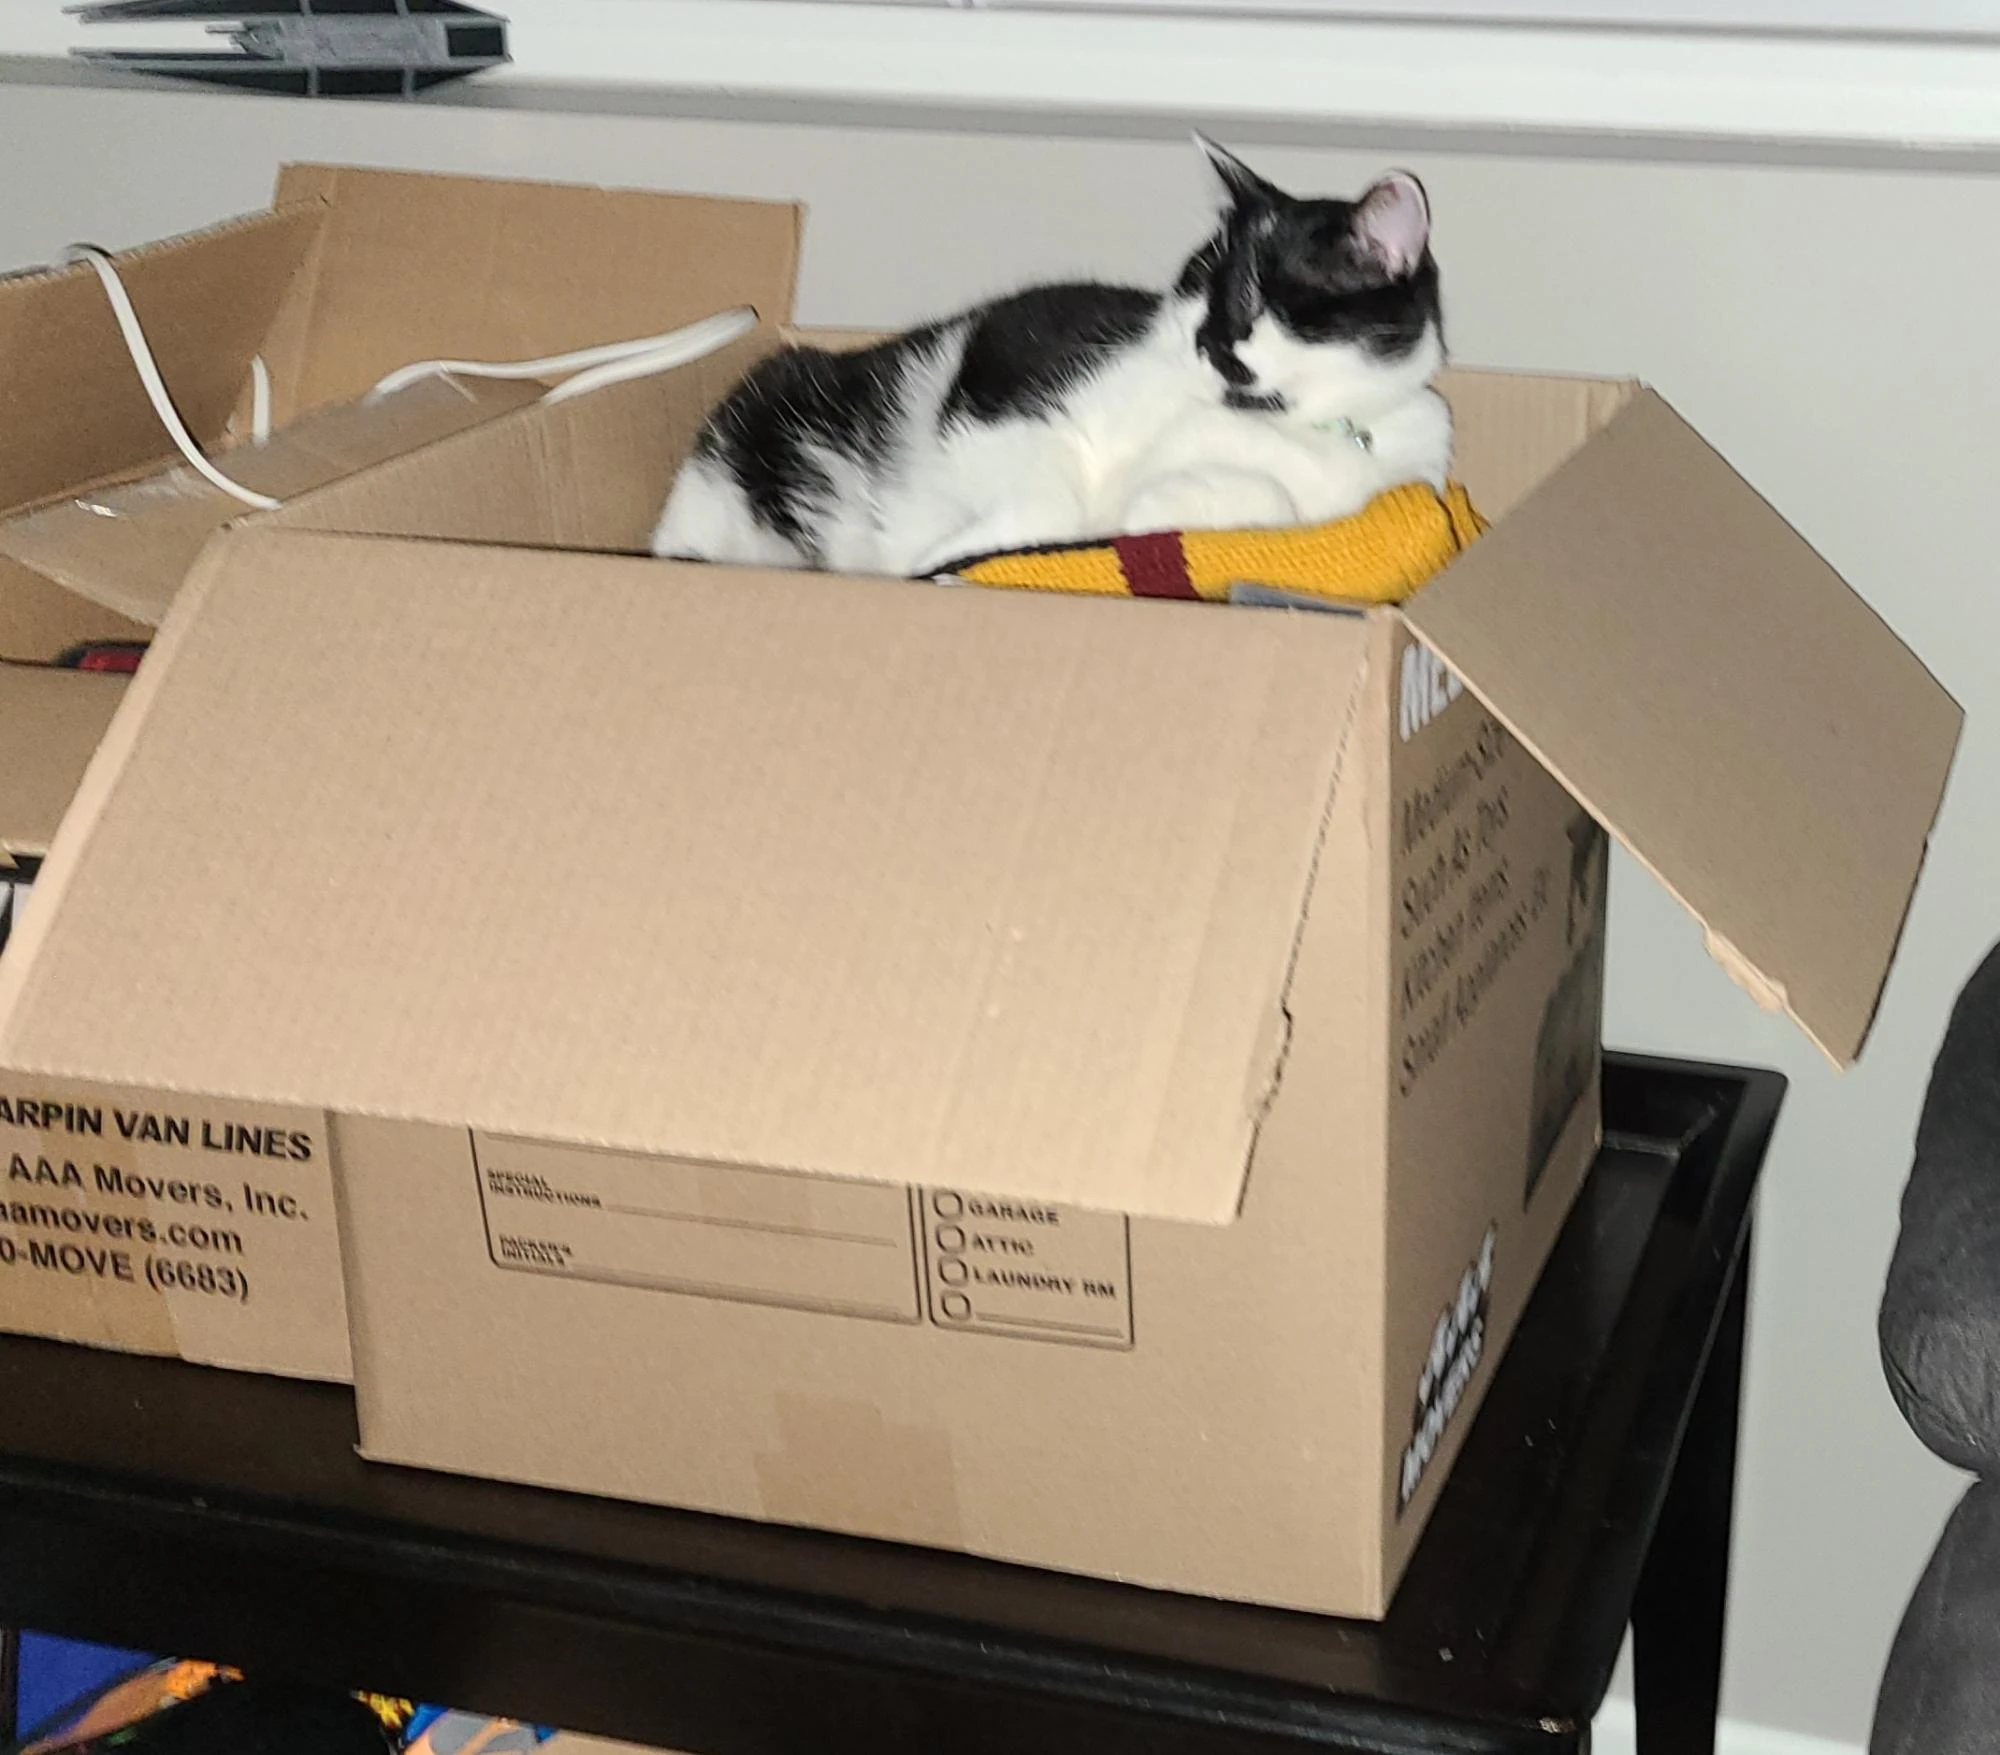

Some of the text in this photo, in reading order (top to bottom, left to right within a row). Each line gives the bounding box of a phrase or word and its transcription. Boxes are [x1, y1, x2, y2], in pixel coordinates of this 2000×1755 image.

[0, 1096, 313, 1163] ARPIN VAN LINES
[8, 1152, 310, 1222] AAA Movers, Inc.
[968, 1200, 1060, 1227] GARAGE
[973, 1233, 1035, 1256] ATTIC
[145, 1253, 249, 1305] (6683)
[973, 1264, 1075, 1296] LAUNDRY
